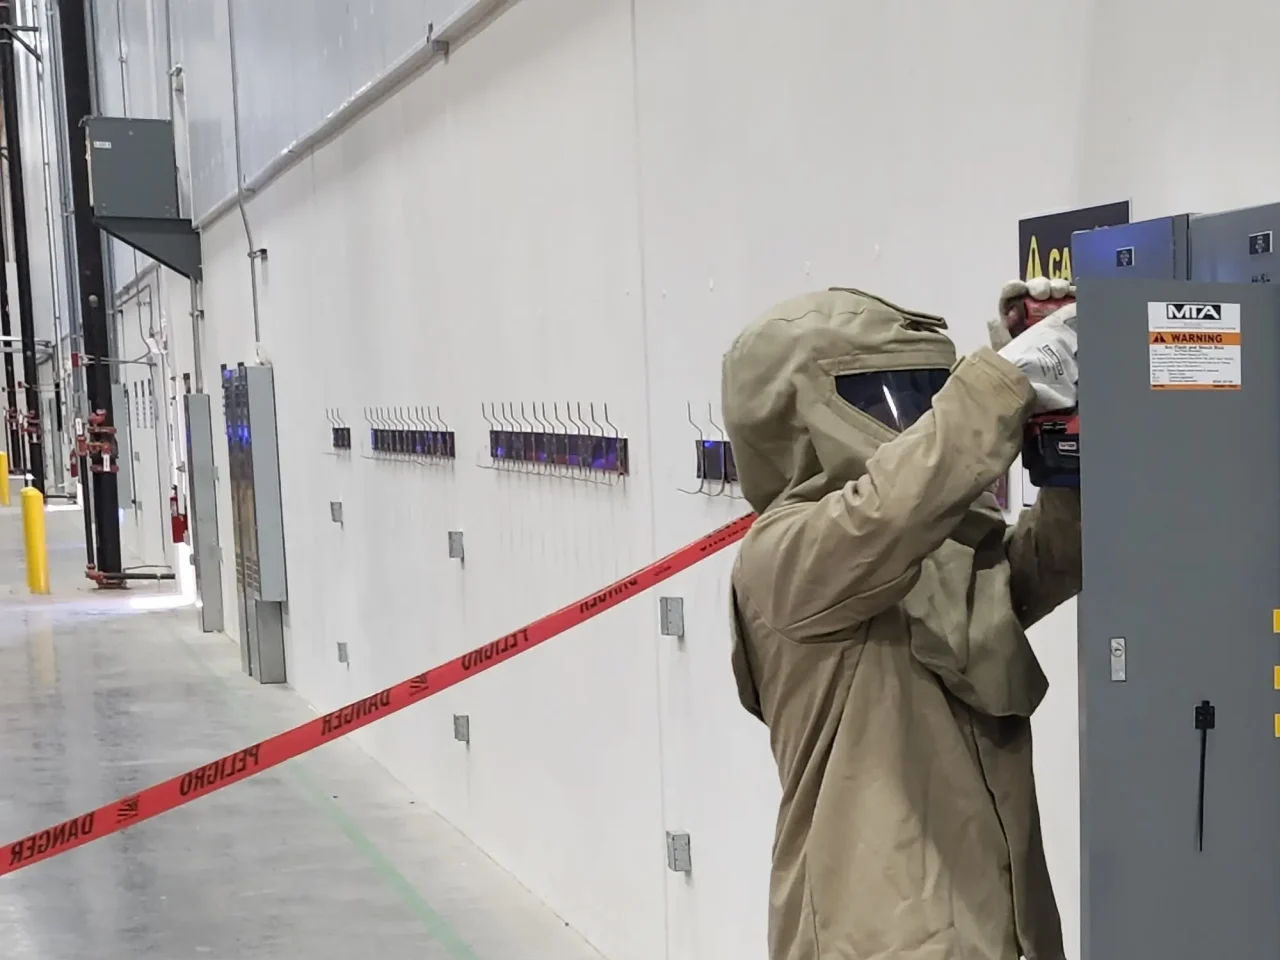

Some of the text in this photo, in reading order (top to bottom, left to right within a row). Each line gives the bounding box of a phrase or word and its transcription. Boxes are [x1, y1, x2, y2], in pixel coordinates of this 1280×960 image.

[1048, 246, 1072, 284] CA
[1167, 304, 1220, 320] MTA
[1171, 333, 1223, 344] WARNING
